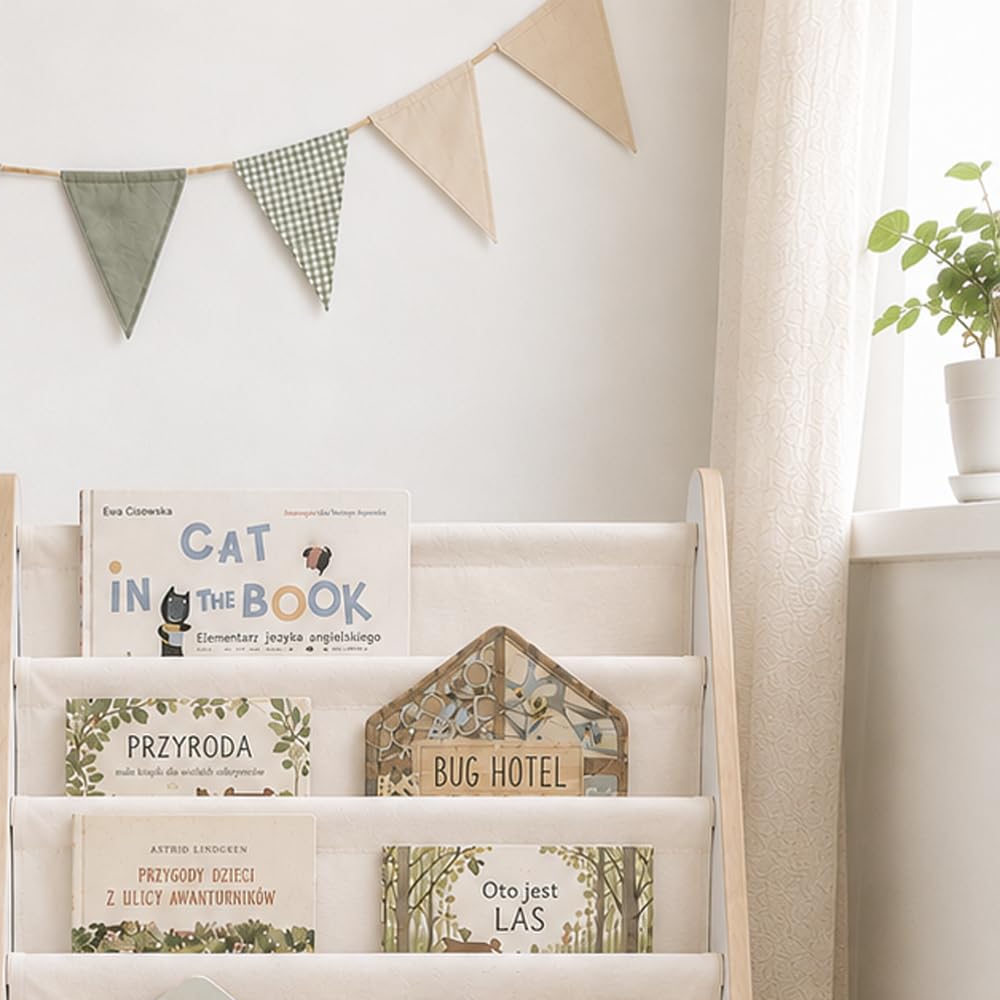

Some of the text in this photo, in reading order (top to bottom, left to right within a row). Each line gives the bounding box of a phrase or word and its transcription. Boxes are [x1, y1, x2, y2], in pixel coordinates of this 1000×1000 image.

[103, 506, 122, 516] Ewa
[180, 522, 271, 563] CAT
[196, 588, 236, 613] THE
[242, 580, 373, 625] BOOK
[309, 632, 381, 645] angielskiego
[128, 735, 253, 758] PRZYRODA
[434, 756, 567, 788] BUG HOTEL
[150, 845, 189, 854] ASTRID
[138, 868, 255, 883] PRZYGODY DZIECI
[106, 886, 276, 906] Z ULICY AWANTURNIKÓW
[482, 881, 558, 904] Oto jest
[495, 907, 545, 931] LAS
